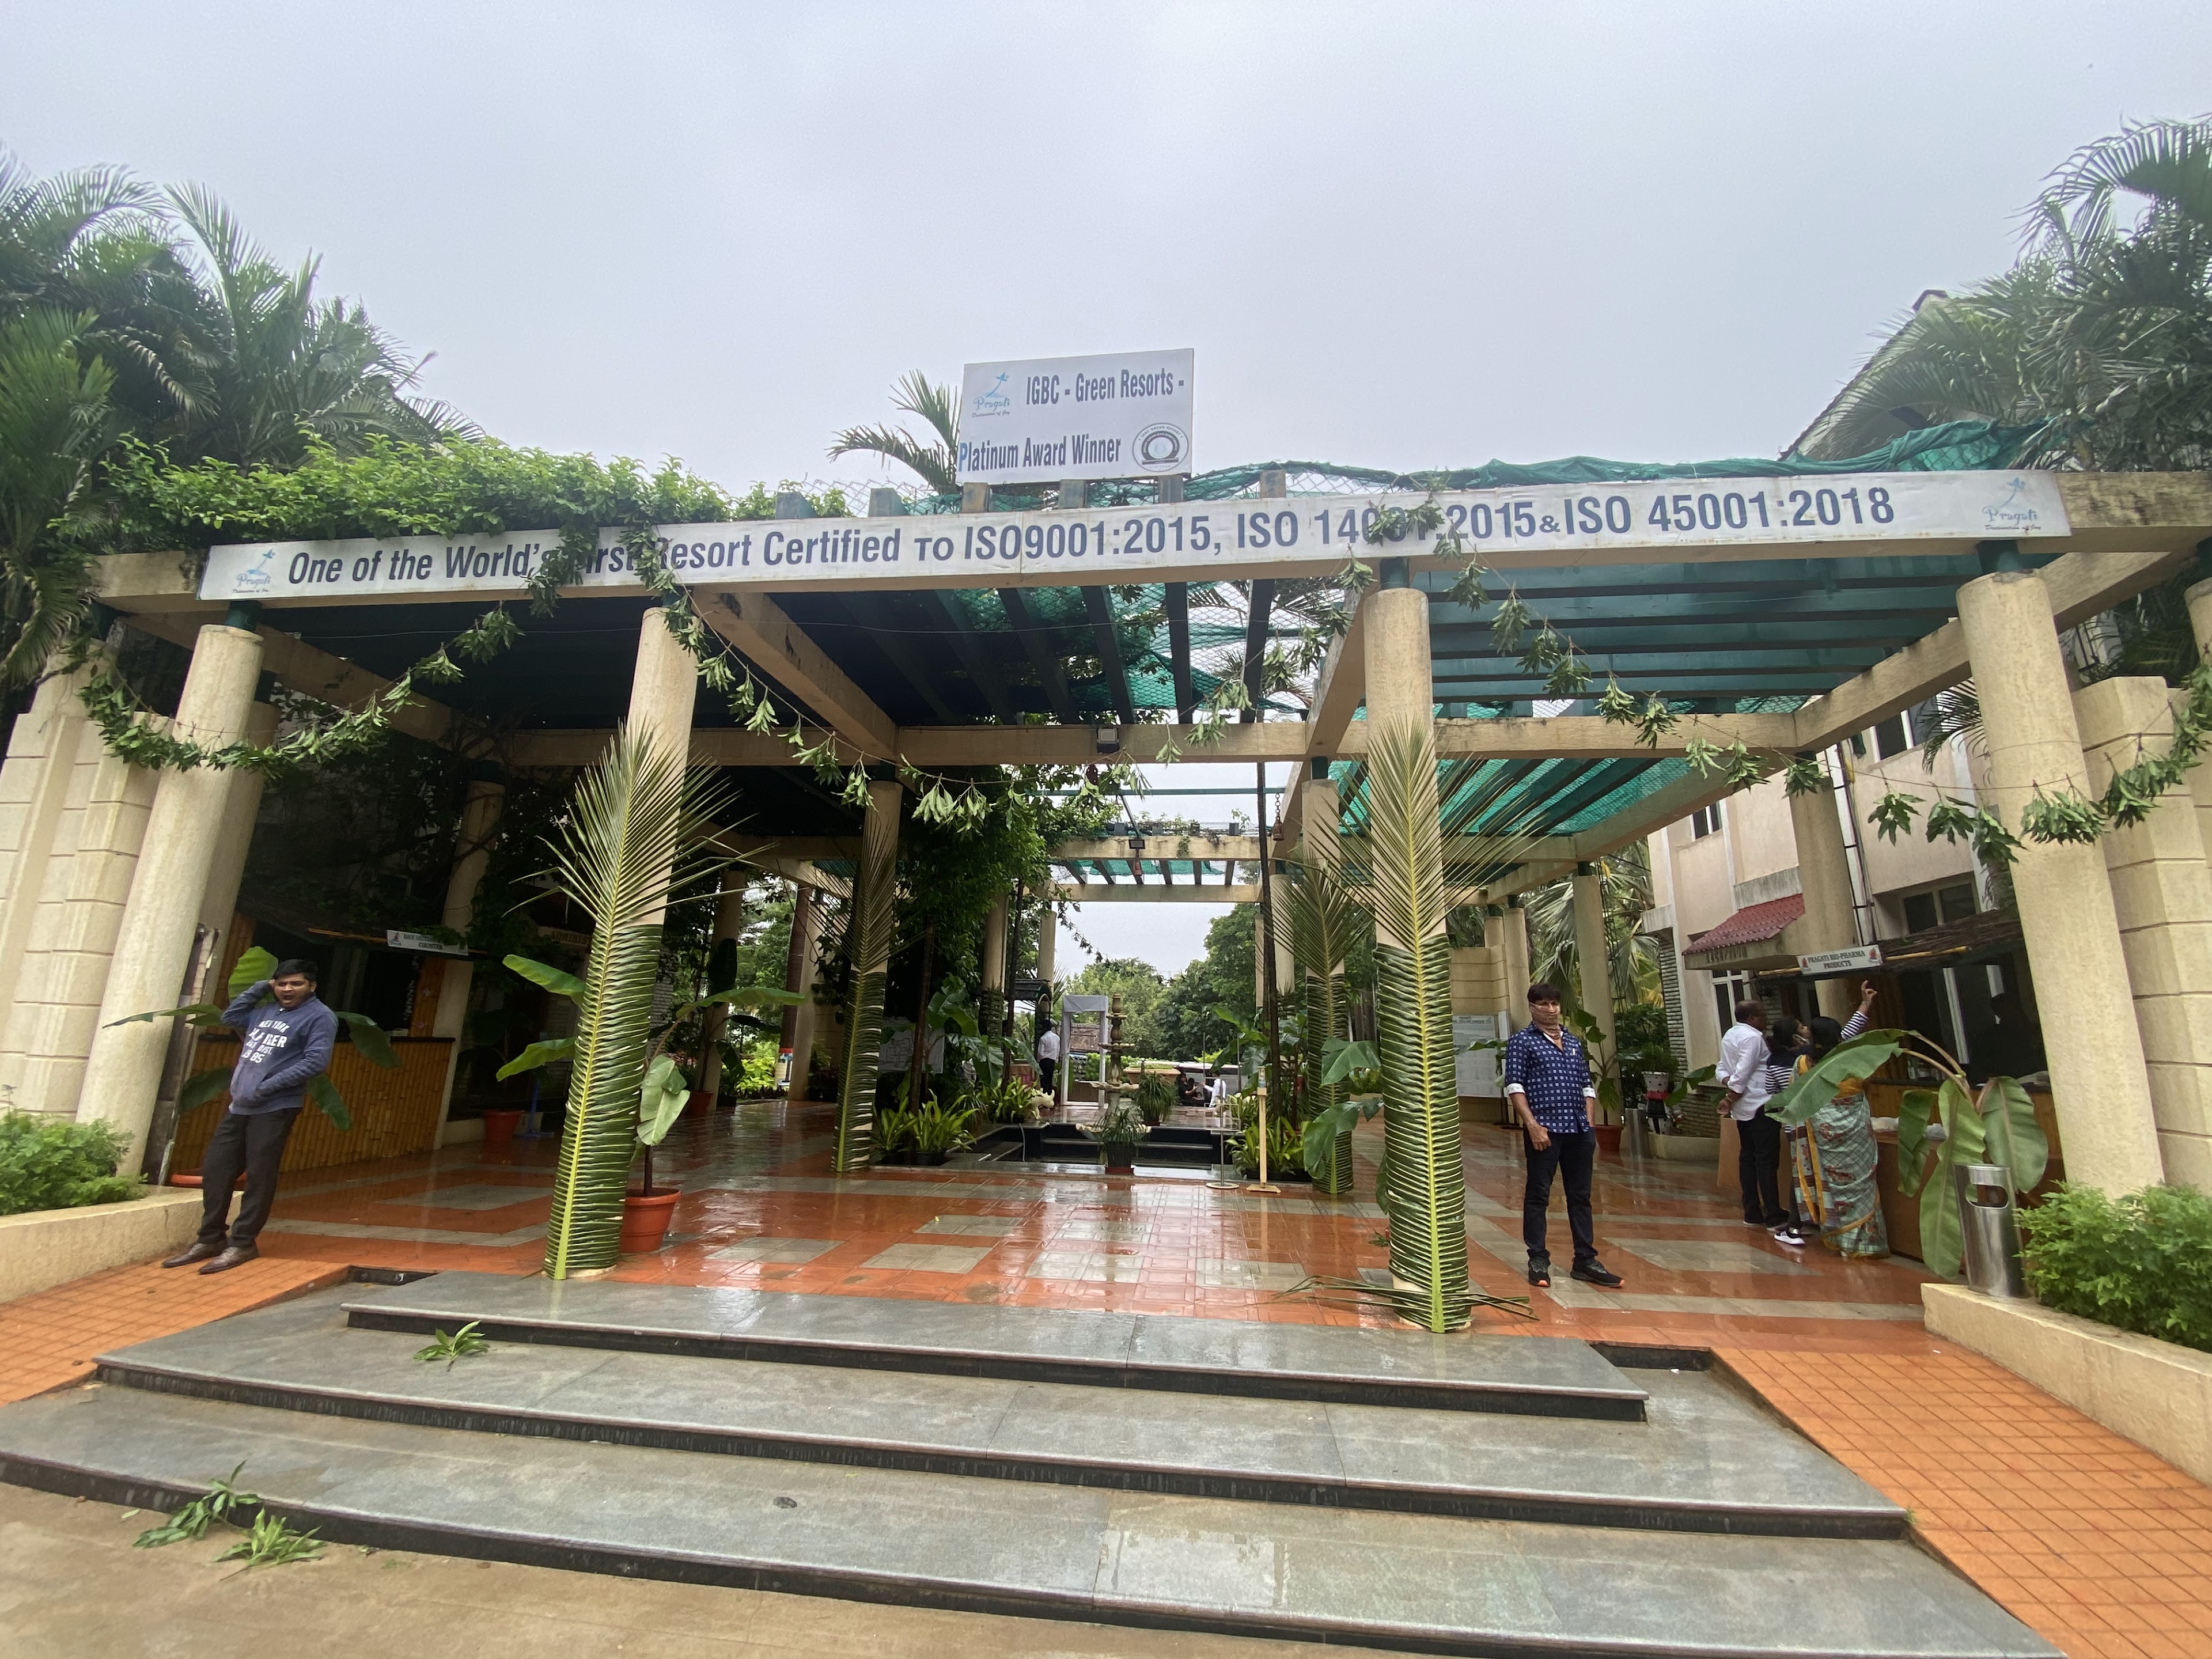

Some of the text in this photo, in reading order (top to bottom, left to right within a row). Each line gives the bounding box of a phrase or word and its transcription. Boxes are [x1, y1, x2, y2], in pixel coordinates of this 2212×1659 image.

[1026, 374, 1059, 405] IGBC
[1075, 373, 1115, 403] Green
[1120, 368, 1173, 398] Resorts
[959, 440, 1018, 472] Platinum
[1023, 435, 1066, 467] Award
[1071, 433, 1121, 465] Winner
[289, 551, 343, 584] One
[352, 550, 382, 582] of
[391, 548, 431, 580] the
[763, 528, 901, 566] Certified
[914, 536, 954, 561] TO
[1237, 510, 1299, 548] ISO
[1648, 487, 1895, 533] 45001:2018
[1823, 960, 1852, 969] PRODUCTS
